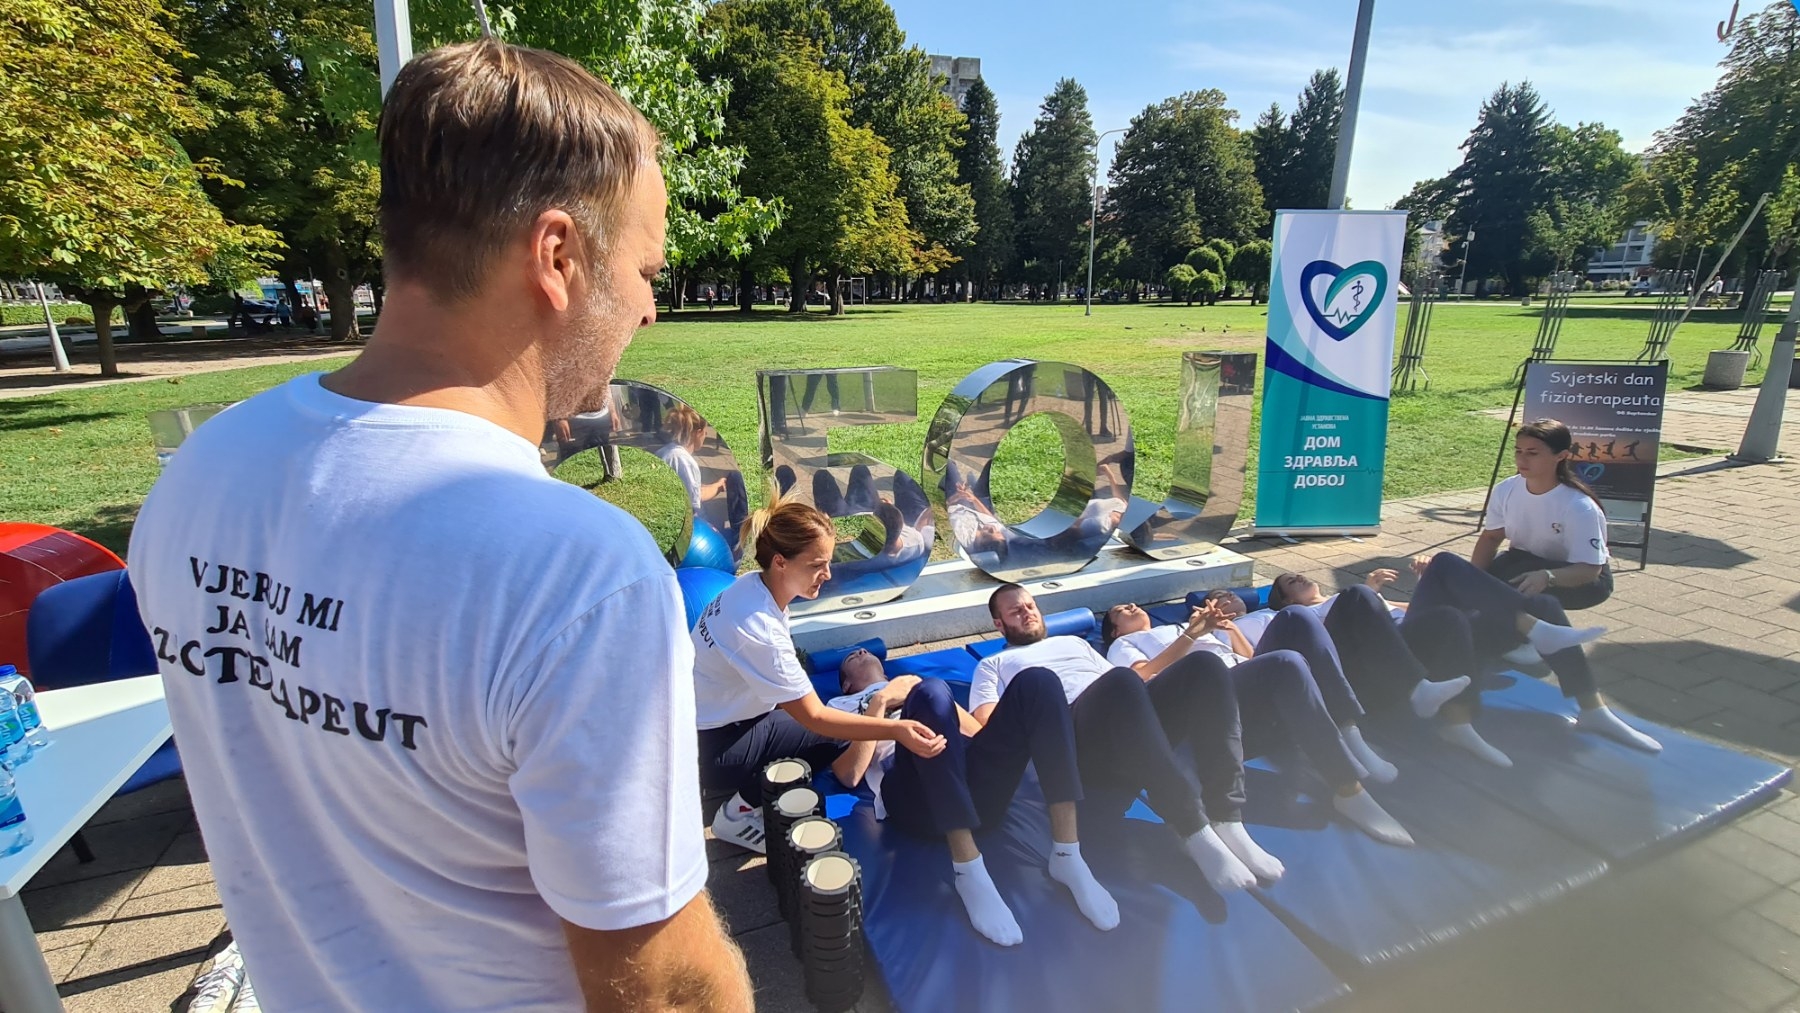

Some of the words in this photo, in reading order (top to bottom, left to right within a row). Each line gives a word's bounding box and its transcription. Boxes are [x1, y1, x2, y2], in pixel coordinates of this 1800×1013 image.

[1549, 371, 1618, 388] Svjetski
[1623, 372, 1655, 386] dan
[1539, 390, 1661, 408] fizioterapeuta
[1303, 435, 1341, 451] ДОМ
[1283, 455, 1359, 470] ЗДРАВЉА
[1293, 474, 1346, 489] ДОБОЈ
[189, 556, 291, 615] VJERUJ
[296, 592, 344, 631] MI
[206, 605, 251, 640] JA
[264, 617, 303, 668] SAM
